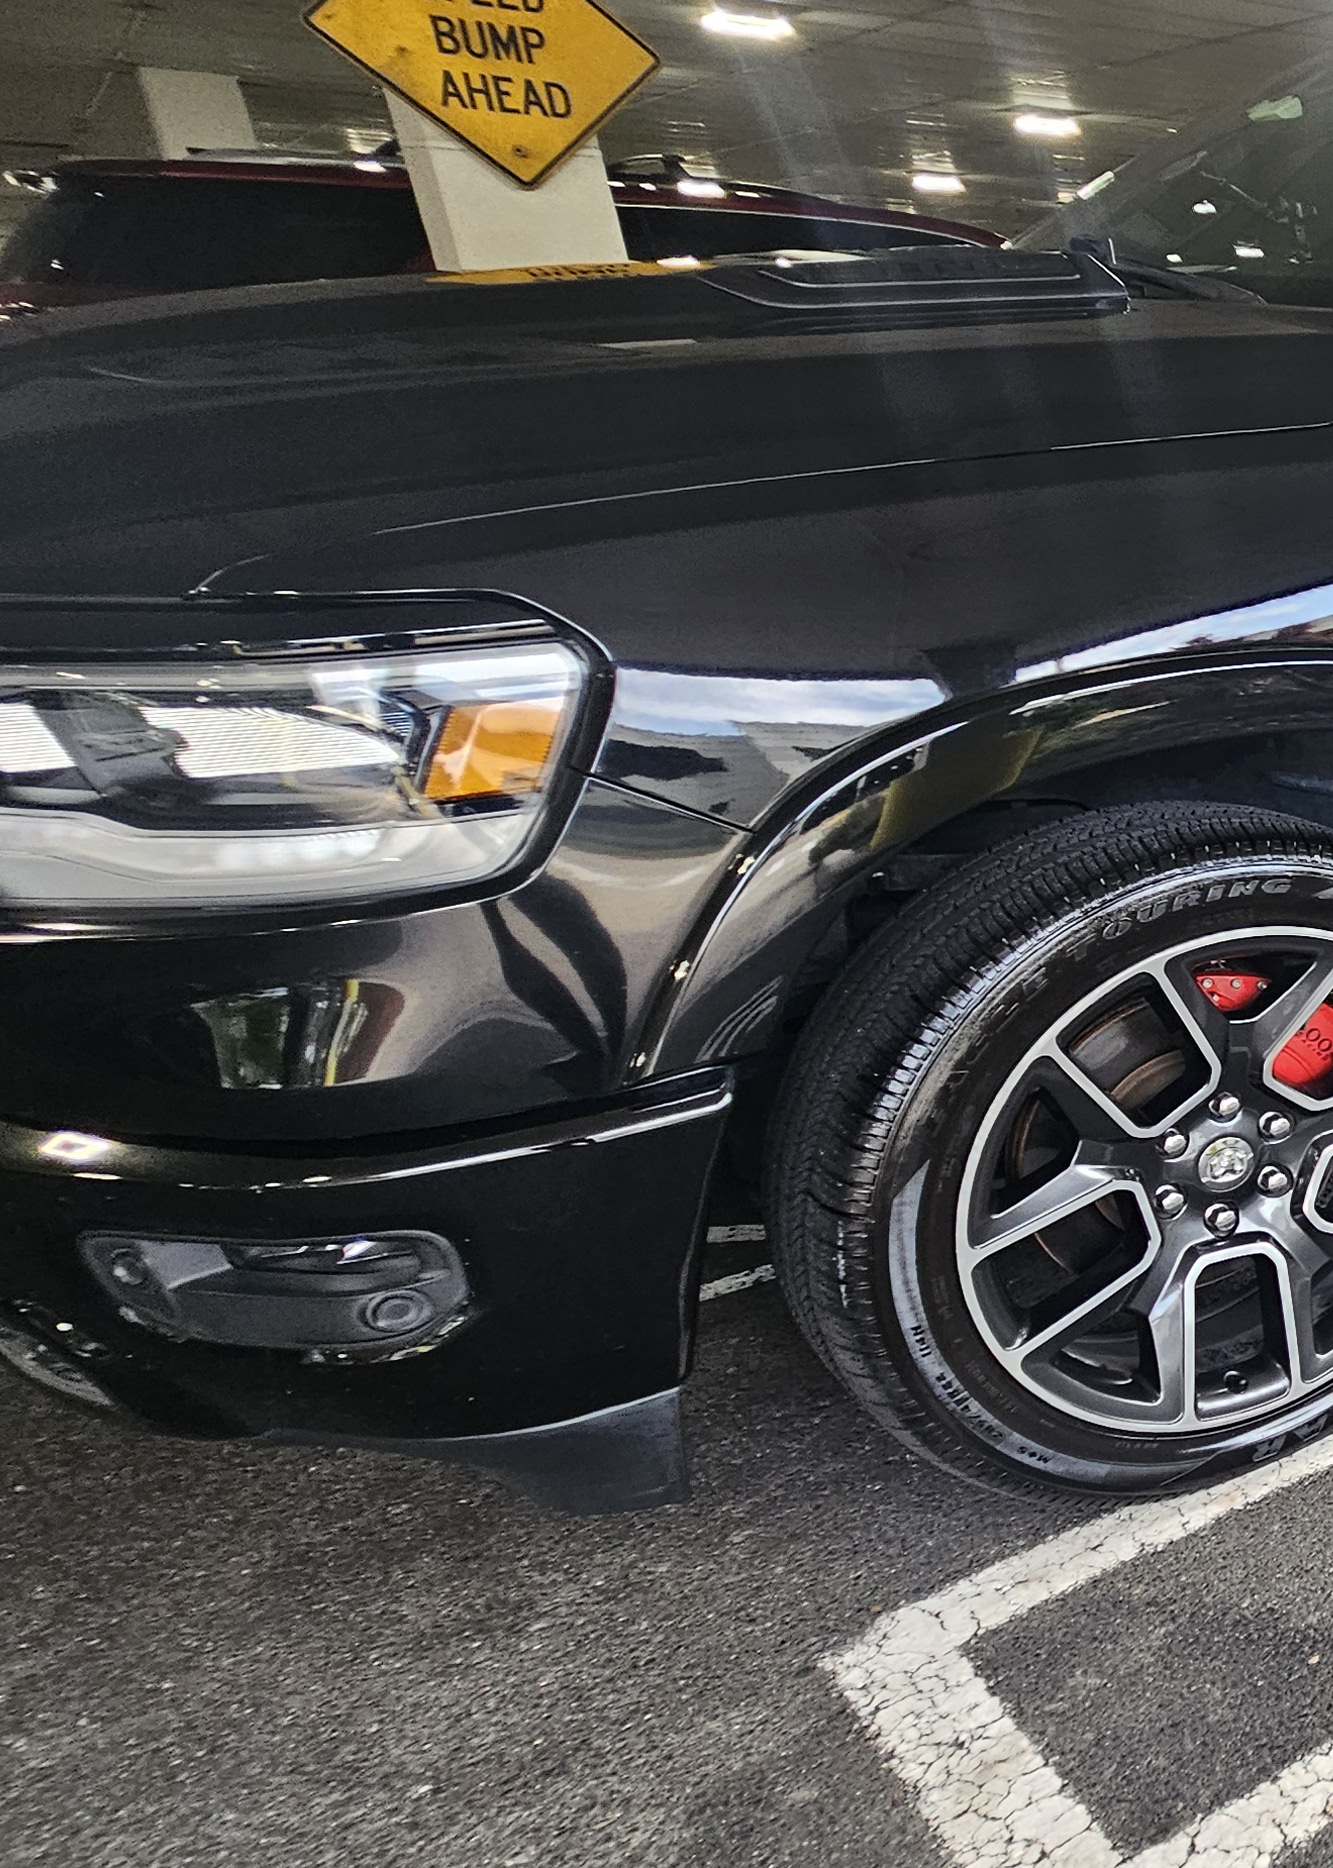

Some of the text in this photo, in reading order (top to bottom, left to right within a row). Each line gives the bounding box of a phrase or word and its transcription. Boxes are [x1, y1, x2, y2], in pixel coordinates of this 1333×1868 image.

[429, 14, 546, 65] BUMP
[441, 69, 573, 119] AHEAD
[1064, 876, 1295, 962] TOURING
